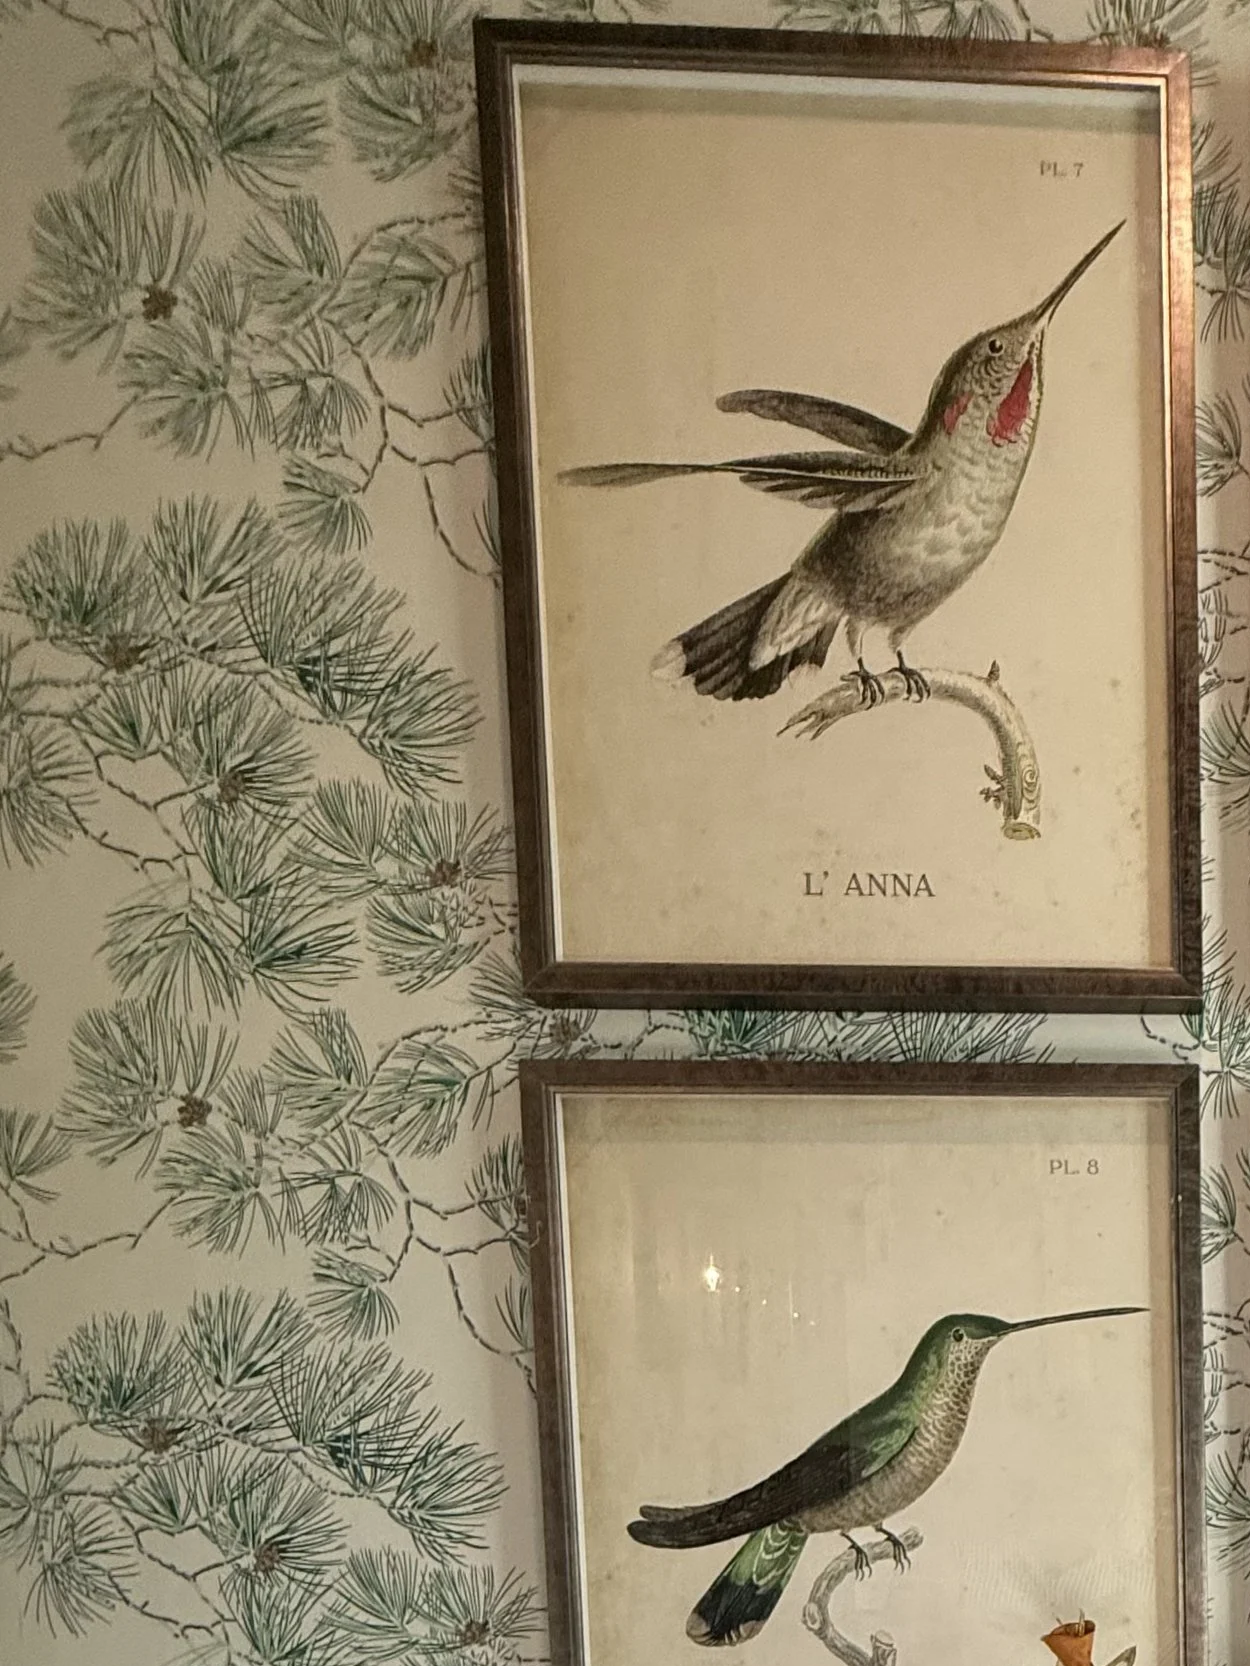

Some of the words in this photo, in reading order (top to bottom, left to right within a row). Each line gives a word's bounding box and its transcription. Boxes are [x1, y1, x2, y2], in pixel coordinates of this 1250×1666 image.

[1073, 162, 1084, 177] 7
[844, 872, 936, 897] ANNA
[1049, 1159, 1080, 1175] PL.
[1087, 1159, 1099, 1175] 8
